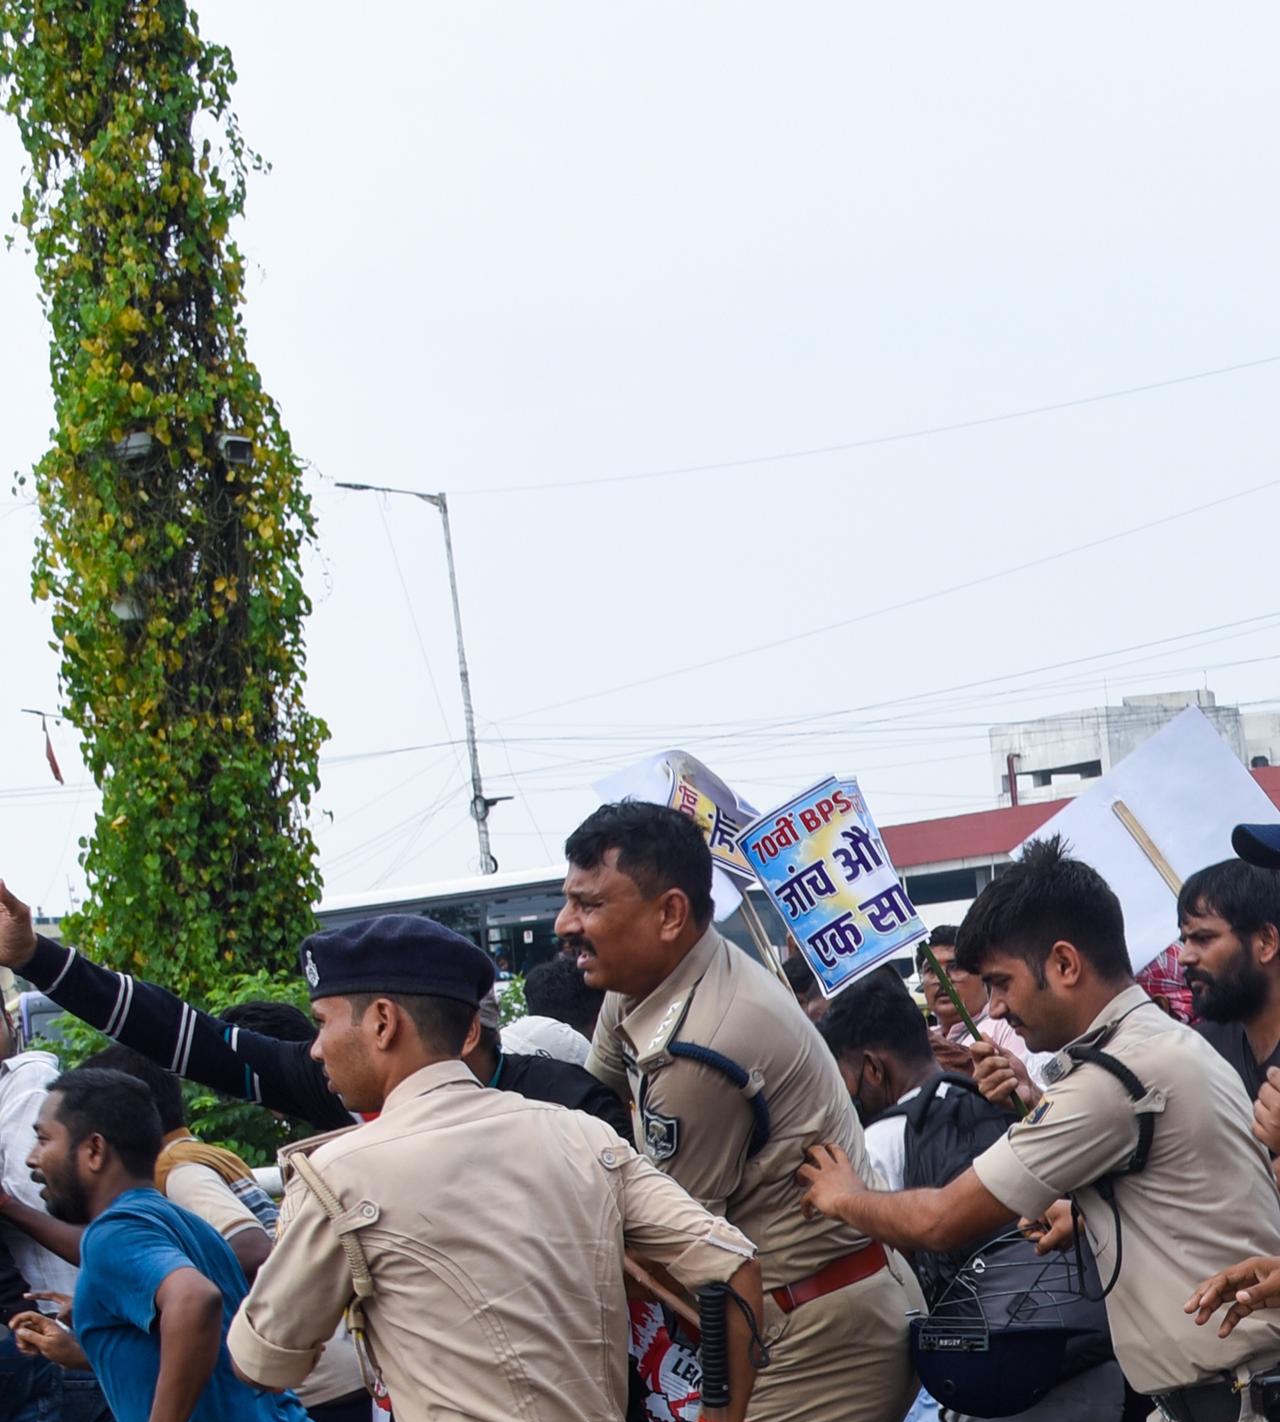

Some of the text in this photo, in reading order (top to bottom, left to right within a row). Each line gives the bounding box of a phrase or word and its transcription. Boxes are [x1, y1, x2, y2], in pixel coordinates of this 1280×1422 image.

[752, 790, 852, 864] 70वीं BPS
[774, 825, 884, 919] जांच औ
[807, 883, 918, 968] एक सा
